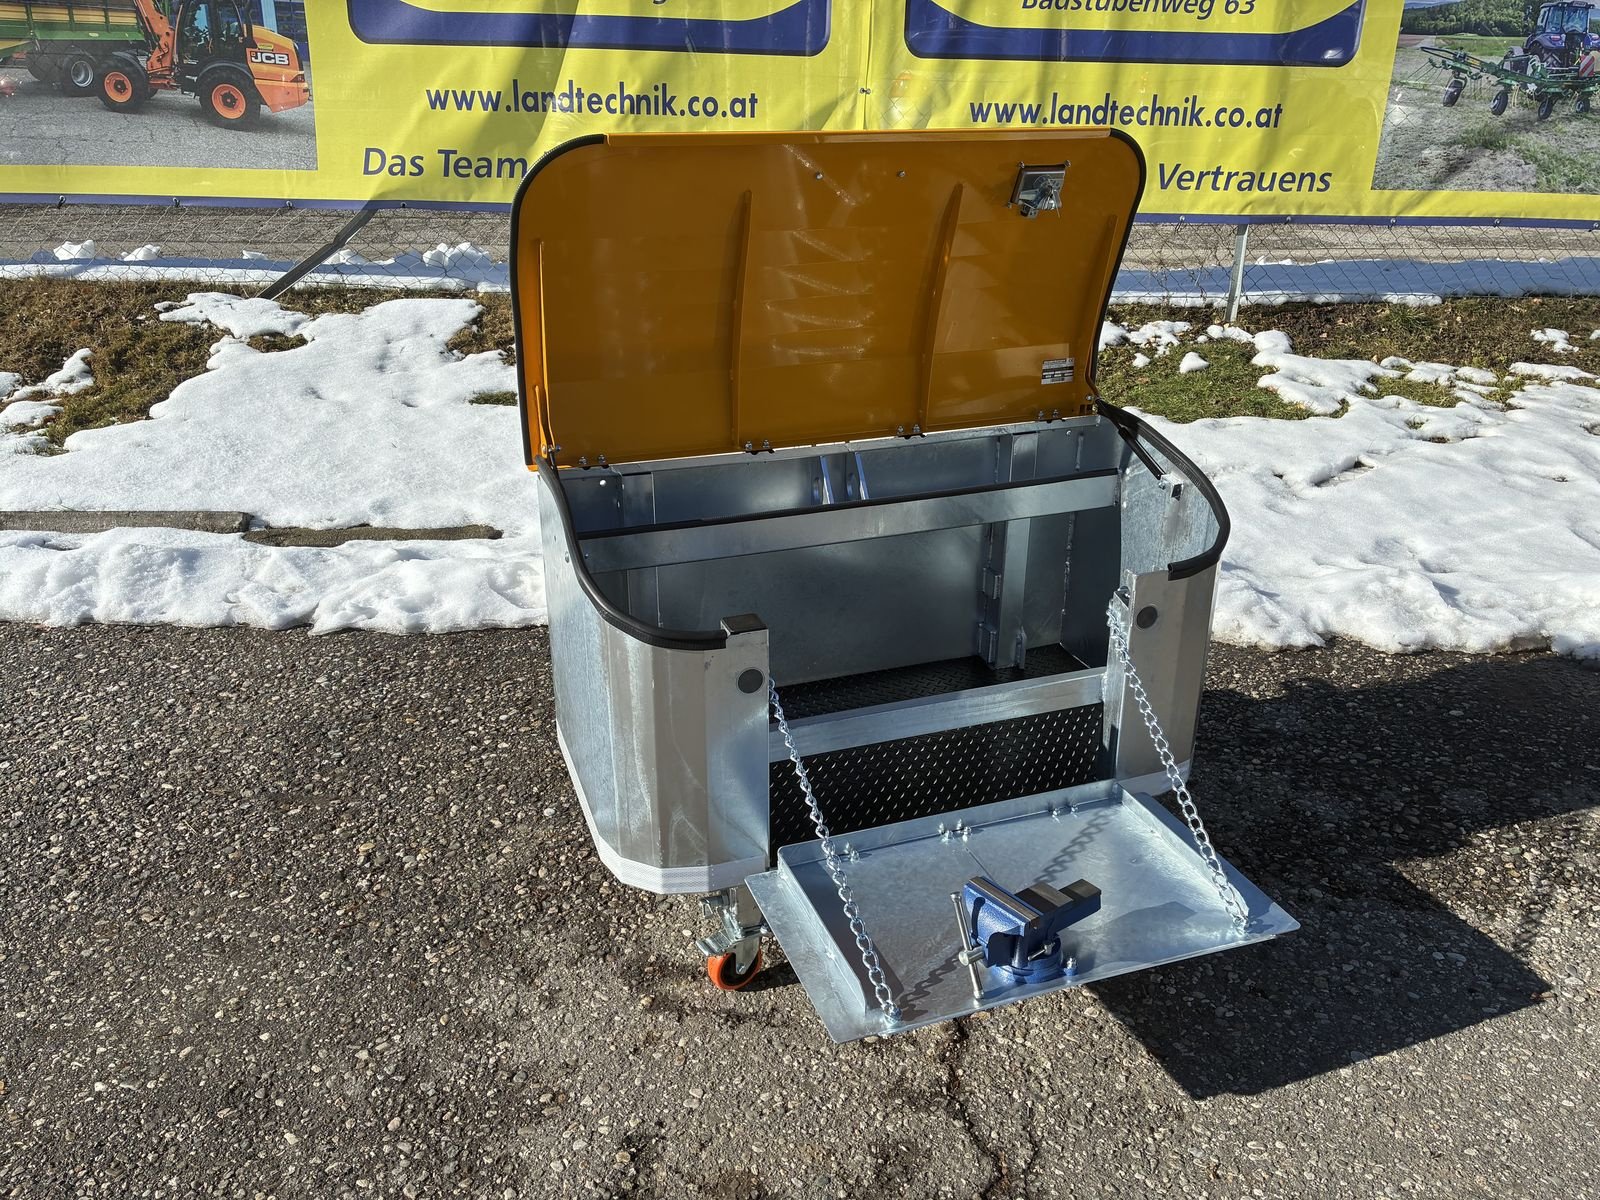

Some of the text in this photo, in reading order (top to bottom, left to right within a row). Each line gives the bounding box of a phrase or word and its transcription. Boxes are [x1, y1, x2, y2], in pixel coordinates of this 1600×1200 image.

[1224, 0, 1256, 15] 63
[251, 52, 289, 65] JCB
[426, 79, 758, 118] www.landtechnik.co.at
[970, 92, 1283, 128] www.landtechnik.co.at
[363, 148, 528, 179] Das Team
[1159, 163, 1333, 193] Vertrauens
